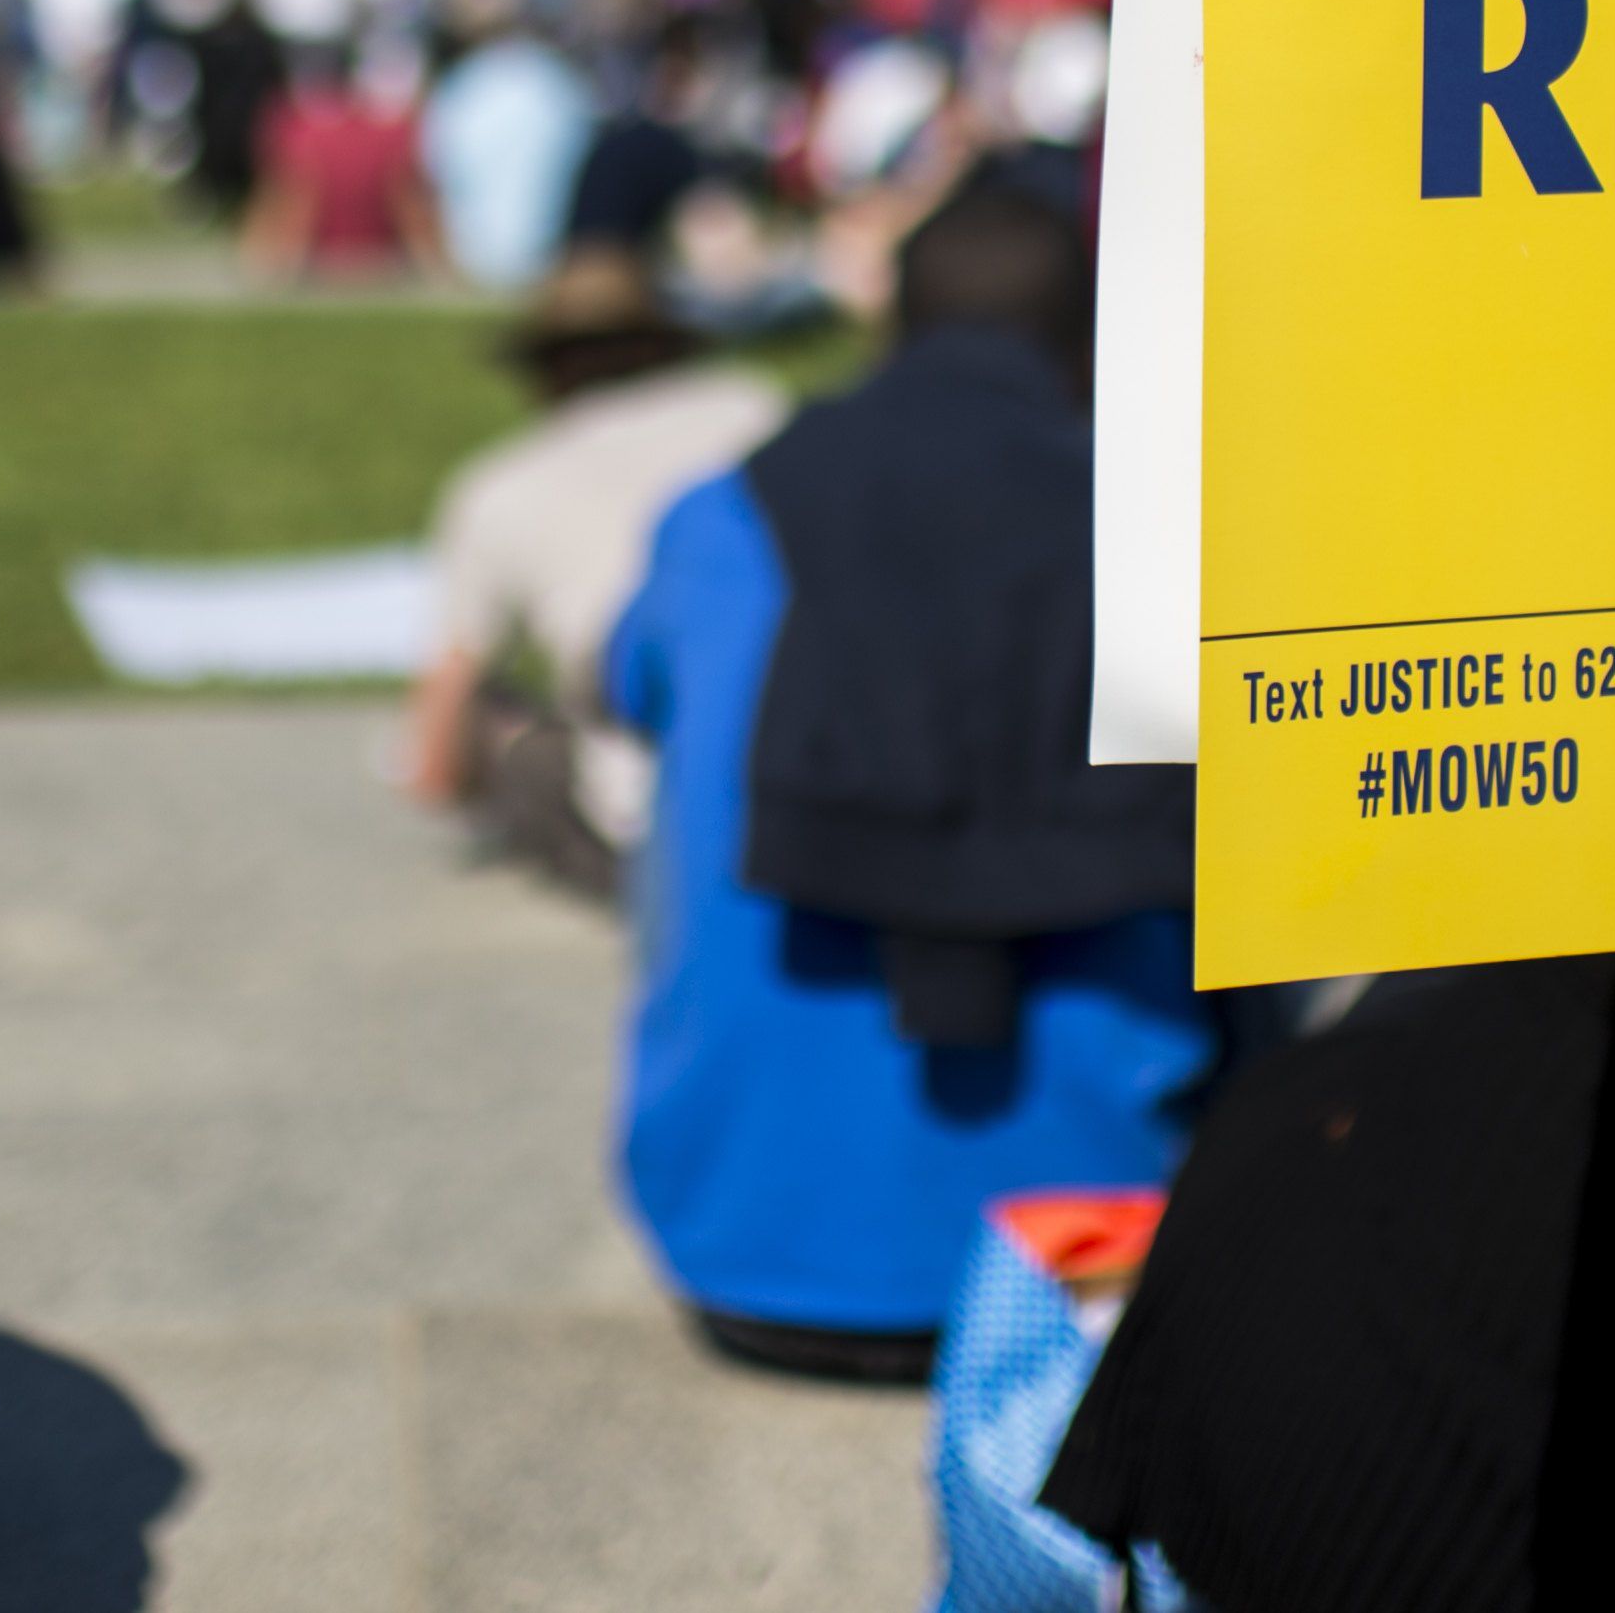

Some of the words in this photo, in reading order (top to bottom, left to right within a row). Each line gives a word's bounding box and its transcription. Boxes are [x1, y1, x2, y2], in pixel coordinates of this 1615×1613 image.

[1243, 670, 1324, 724] Text
[1340, 653, 1504, 717] JUSTICE
[1522, 653, 1557, 703] to
[1357, 737, 1579, 819] #MOW50
